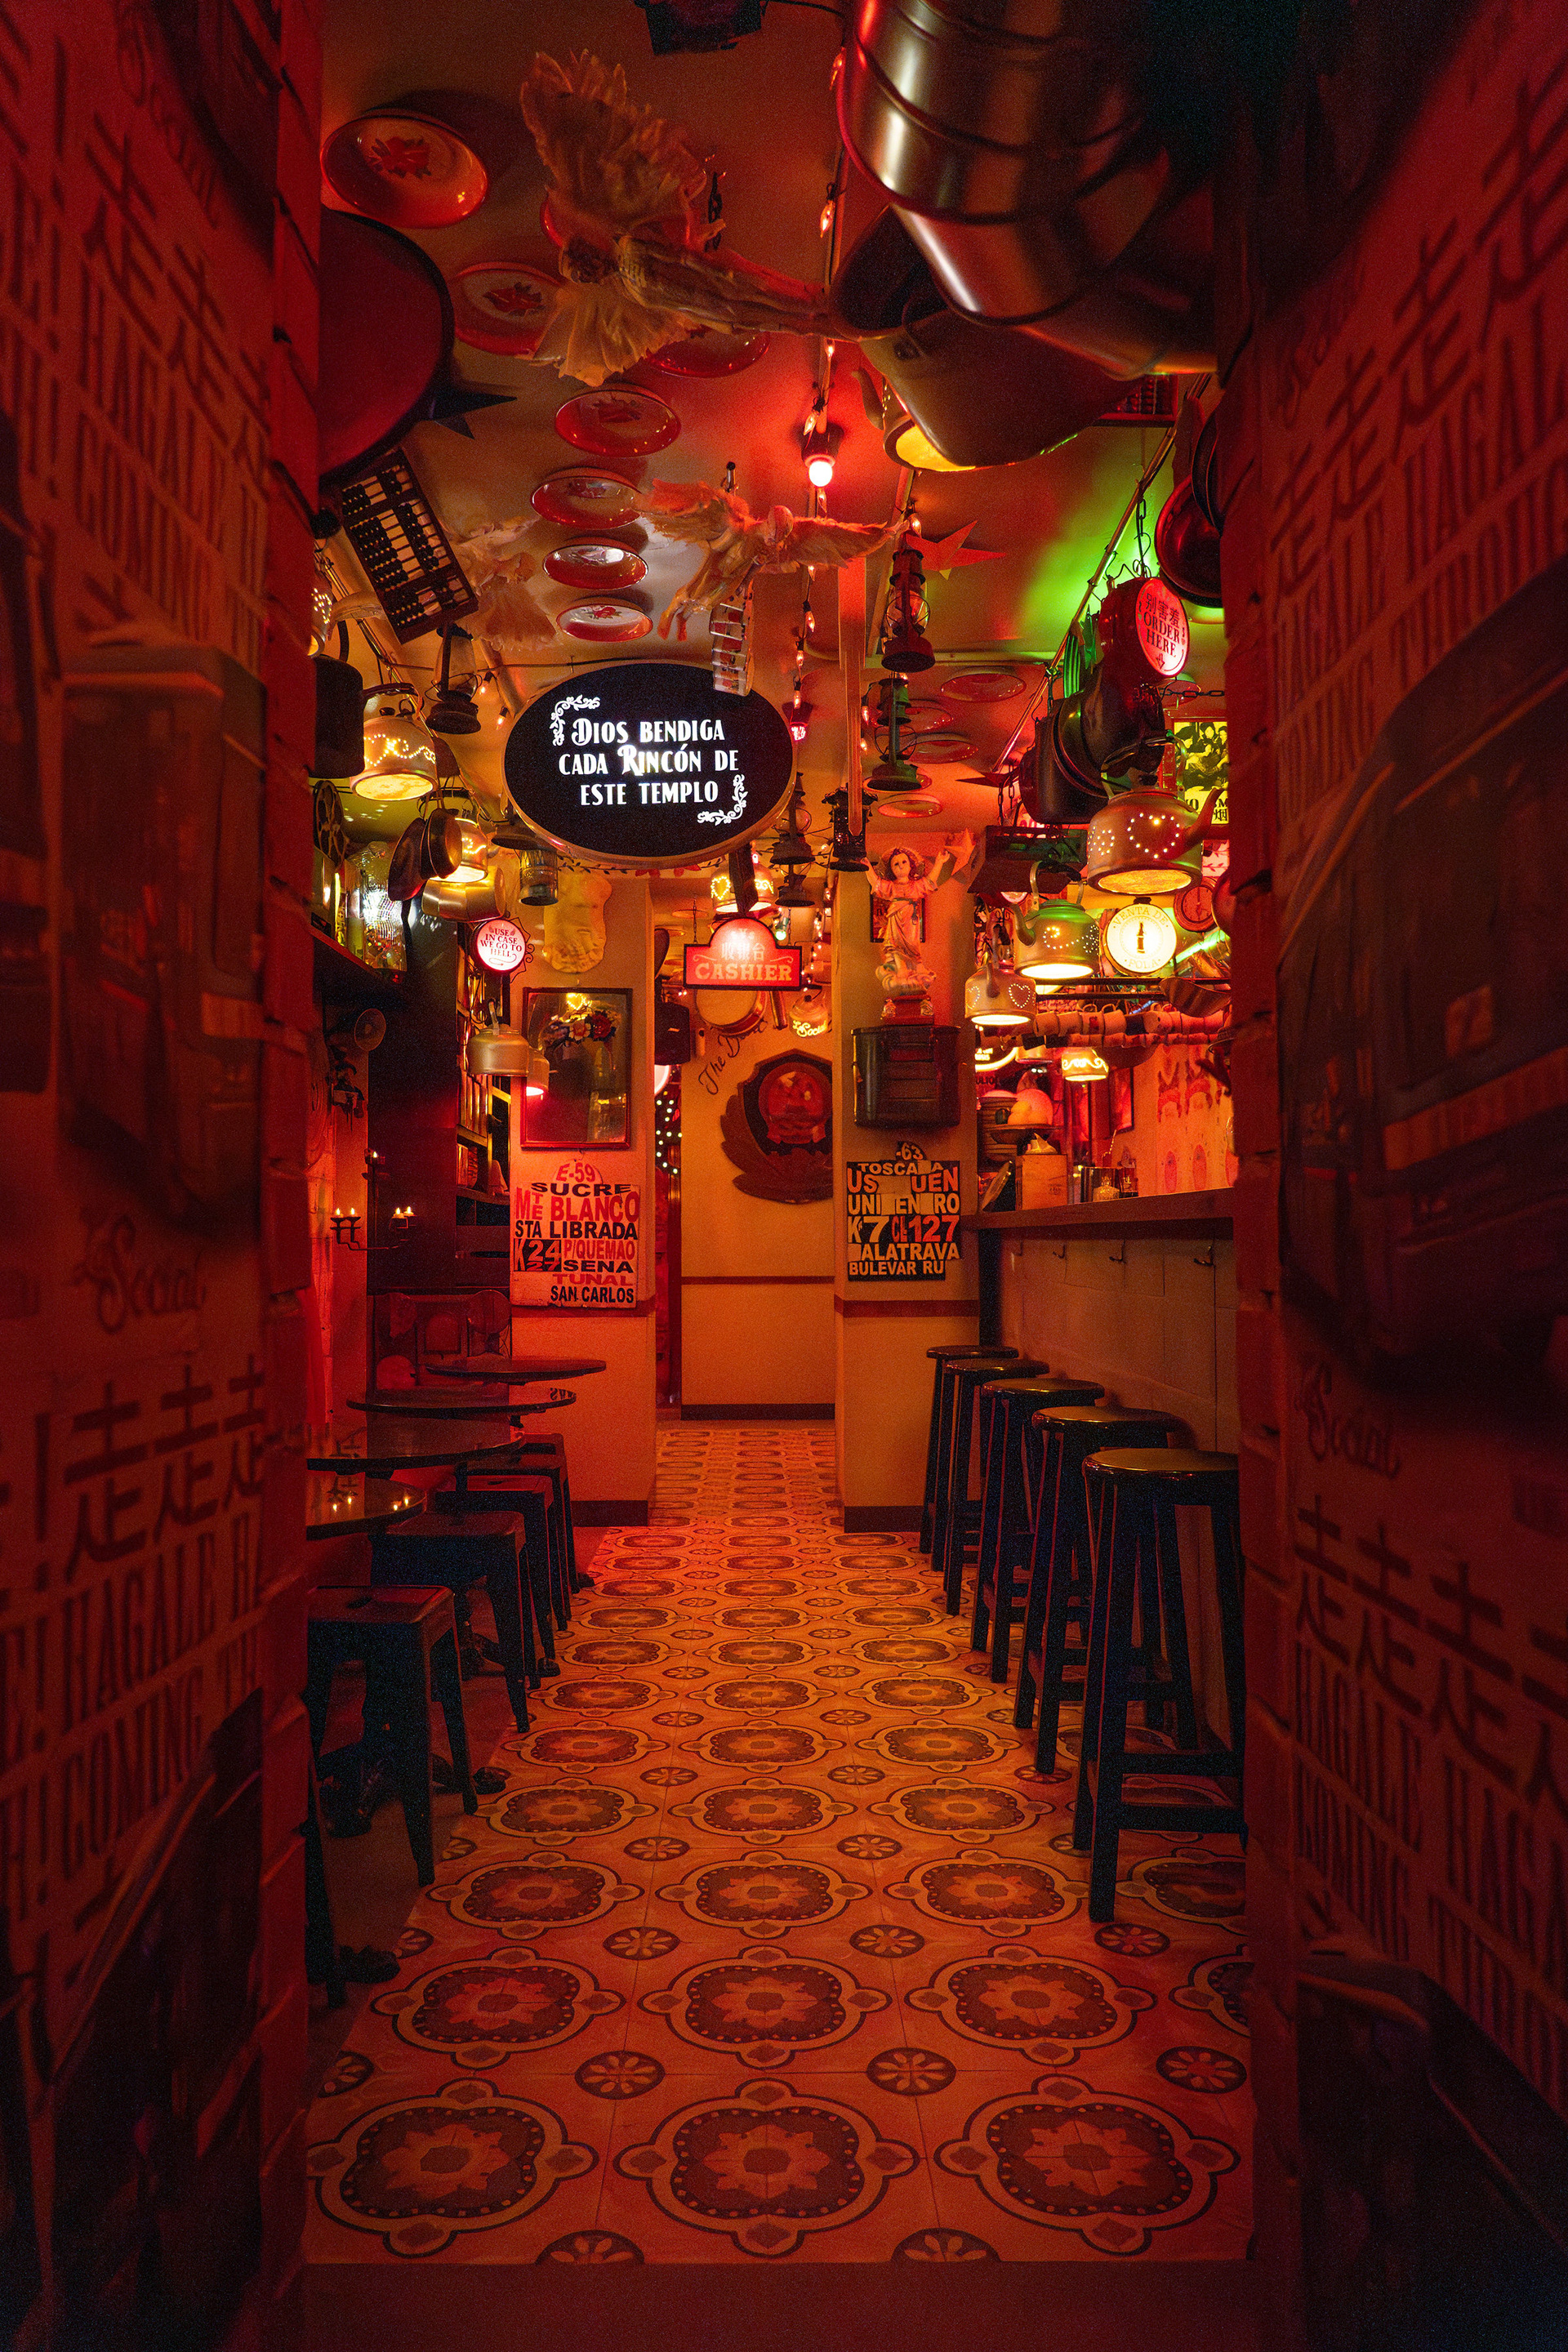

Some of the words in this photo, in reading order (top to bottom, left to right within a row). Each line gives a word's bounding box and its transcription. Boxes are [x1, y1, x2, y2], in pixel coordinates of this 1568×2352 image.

[1143, 612, 1179, 644] ORDER
[1147, 628, 1176, 657] HERE
[572, 719, 629, 746] DIOS
[640, 719, 725, 744] BENDIGA
[559, 753, 608, 775] CADA
[617, 744, 702, 777] RINCÓN
[715, 750, 739, 771] DE
[581, 783, 627, 806] ESTE
[639, 781, 719, 804] TEMPLO
[1113, 906, 1150, 925] VENTA
[1154, 909, 1167, 925] DE
[485, 933, 496, 942] IN
[497, 936, 518, 945] CASE
[494, 928, 510, 937] USE
[480, 940, 495, 948] WE
[510, 944, 523, 952] TO
[490, 948, 512, 957] HELL
[695, 963, 792, 981] CASHIER
[1128, 958, 1159, 969] POLA
[555, 1162, 595, 1183] E-59
[858, 1162, 944, 1175] TOSCAA
[847, 1166, 959, 1193] USUEN
[531, 1183, 631, 1197] SUCRE
[550, 1191, 639, 1223] BLANCO
[848, 1192, 960, 1215] UNIENRO
[515, 1220, 542, 1238] STA
[550, 1221, 639, 1240] LIBRADA
[908, 1214, 960, 1242] 127
[848, 1242, 960, 1262] ALATRAVA
[564, 1259, 634, 1273] SENA
[849, 1261, 917, 1276] BULEVAR
[552, 1273, 634, 1286] TUNAL
[550, 1285, 578, 1302] SAN
[581, 1286, 634, 1303] CARLOS
